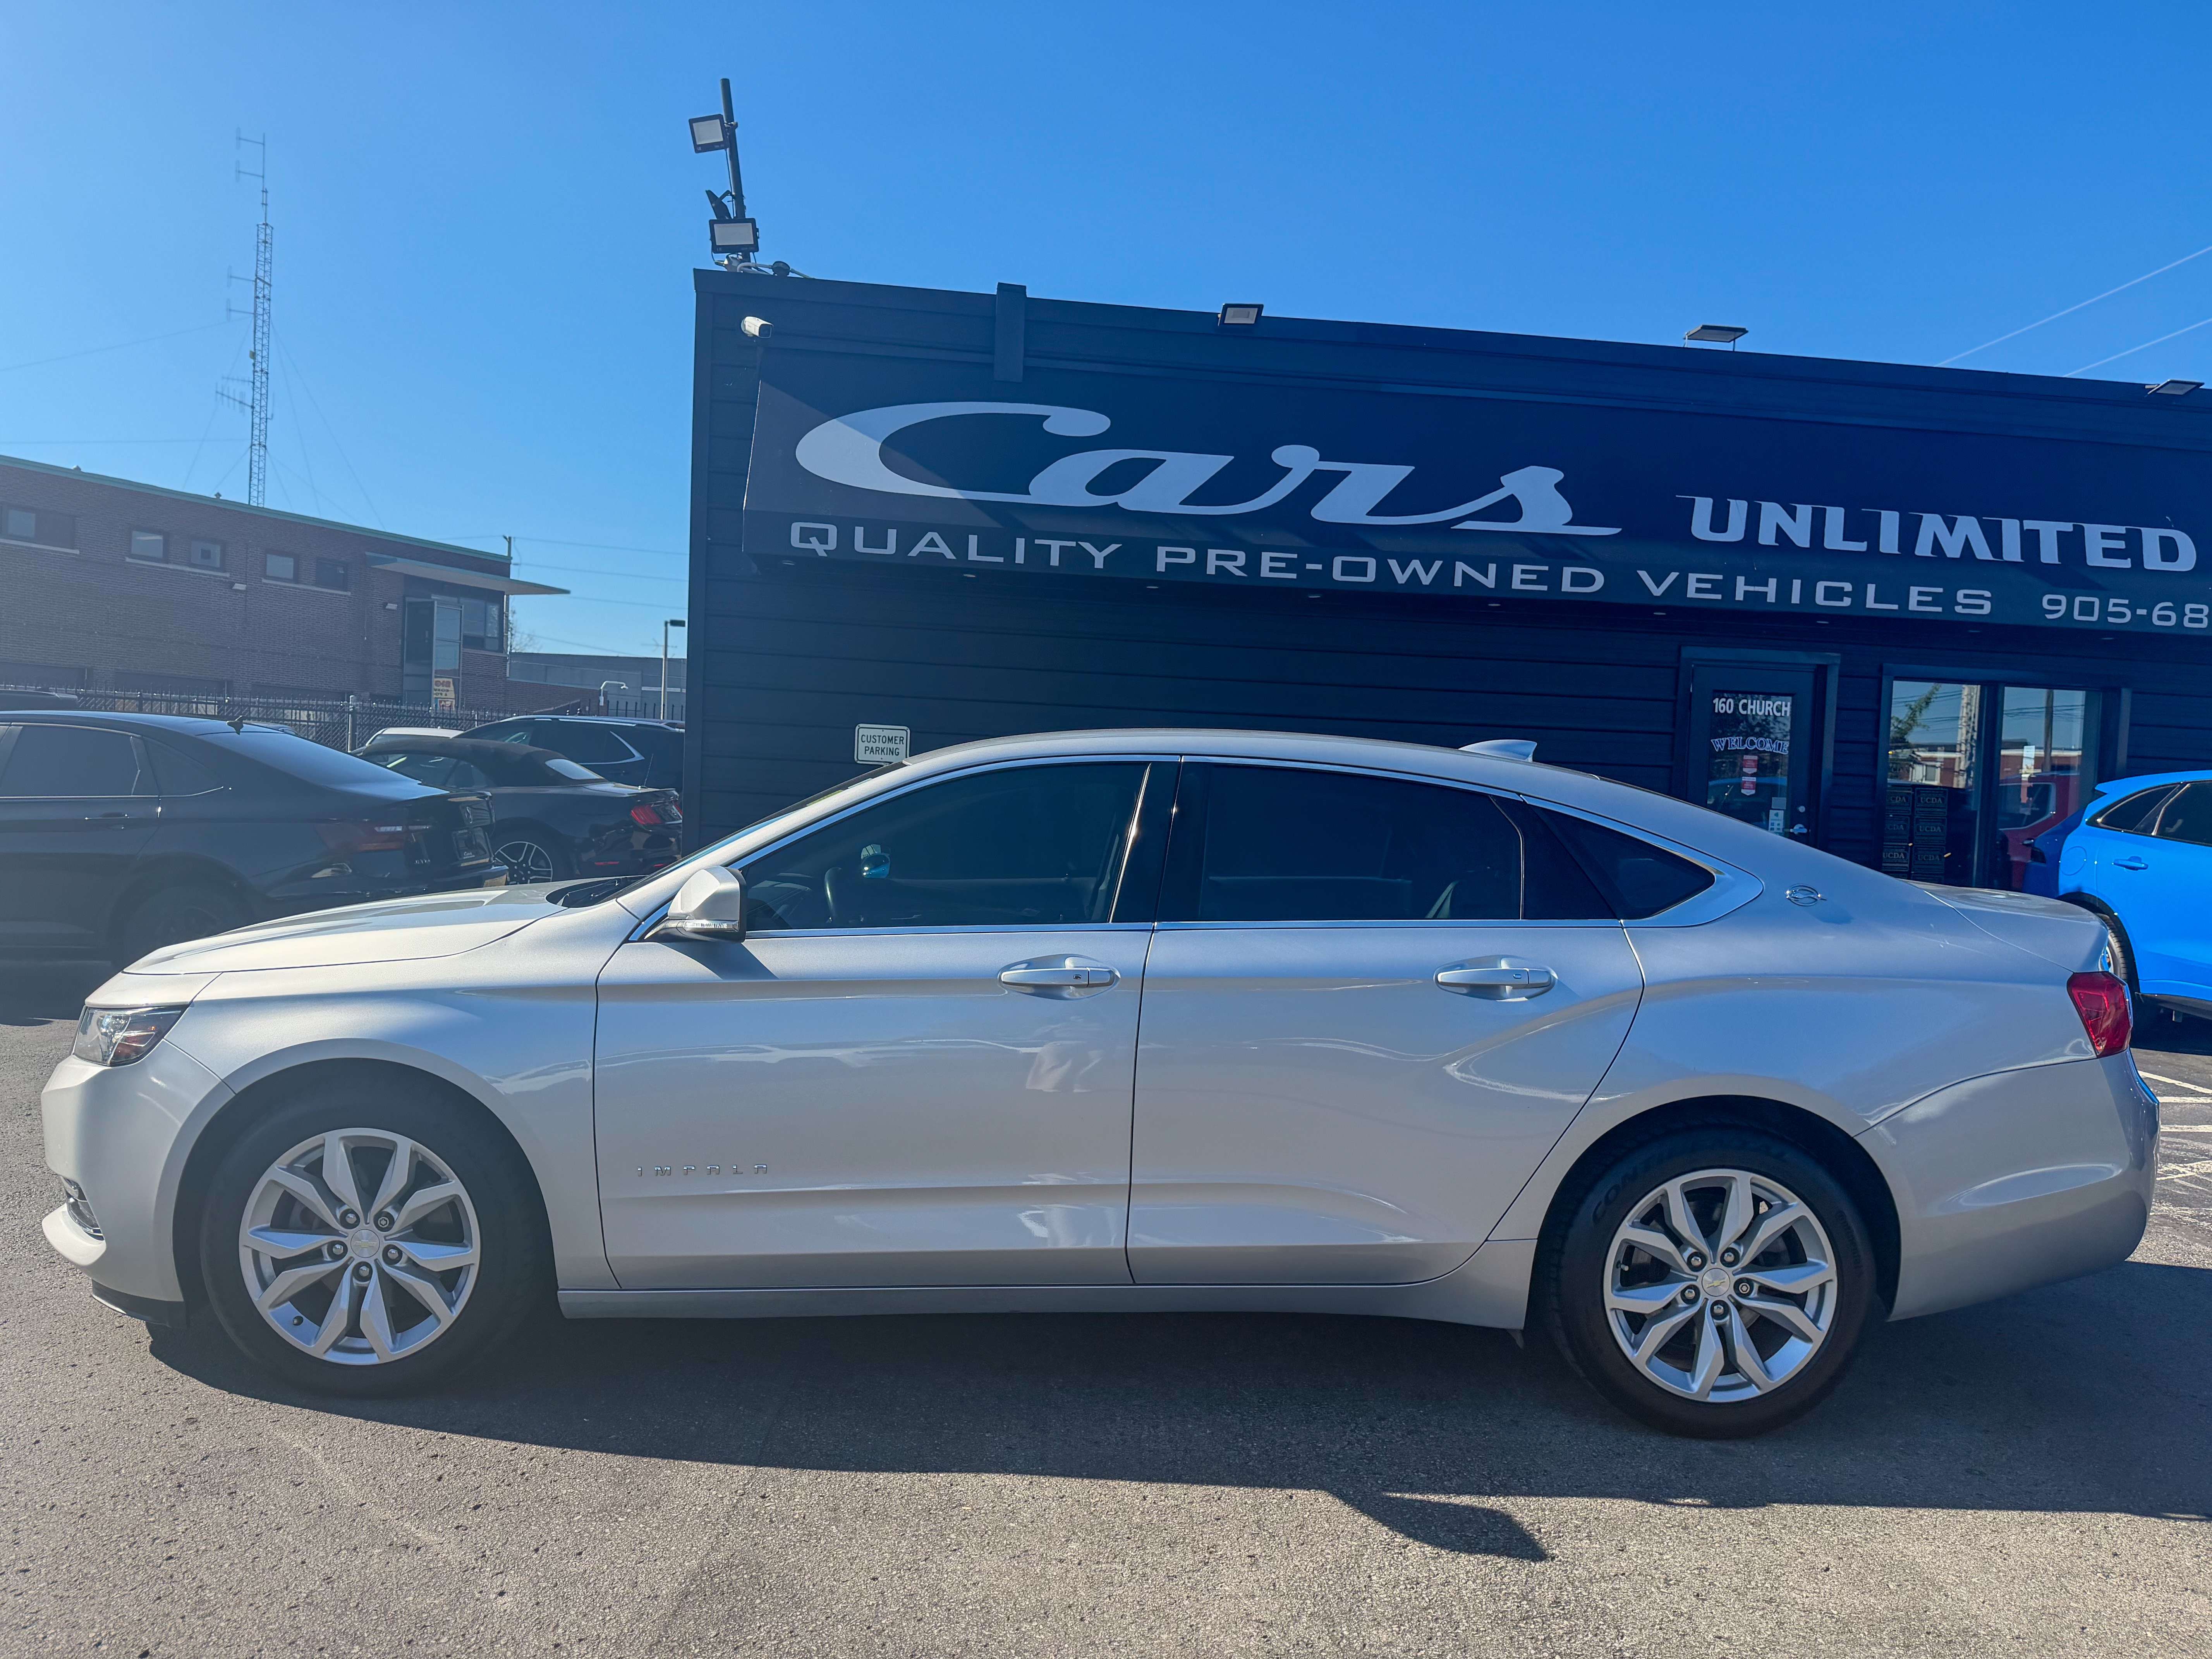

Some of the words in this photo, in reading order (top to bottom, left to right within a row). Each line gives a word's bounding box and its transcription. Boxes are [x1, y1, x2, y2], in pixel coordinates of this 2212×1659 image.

[796, 402, 1622, 535] Cars
[1676, 495, 2197, 572] UNLIMITED
[790, 522, 1123, 568] QUALITY
[1156, 546, 1604, 593] PRE-OWNED
[1636, 570, 1992, 615] VEHICLES
[2042, 594, 2209, 628] 905-68
[1713, 697, 1734, 714] 160
[1738, 699, 1791, 717] CHURCH
[861, 734, 904, 745] CUSTOMER
[1710, 737, 1790, 755] WELCOME
[864, 746, 900, 756] PARKING
[637, 1164, 768, 1177] IMPALA
